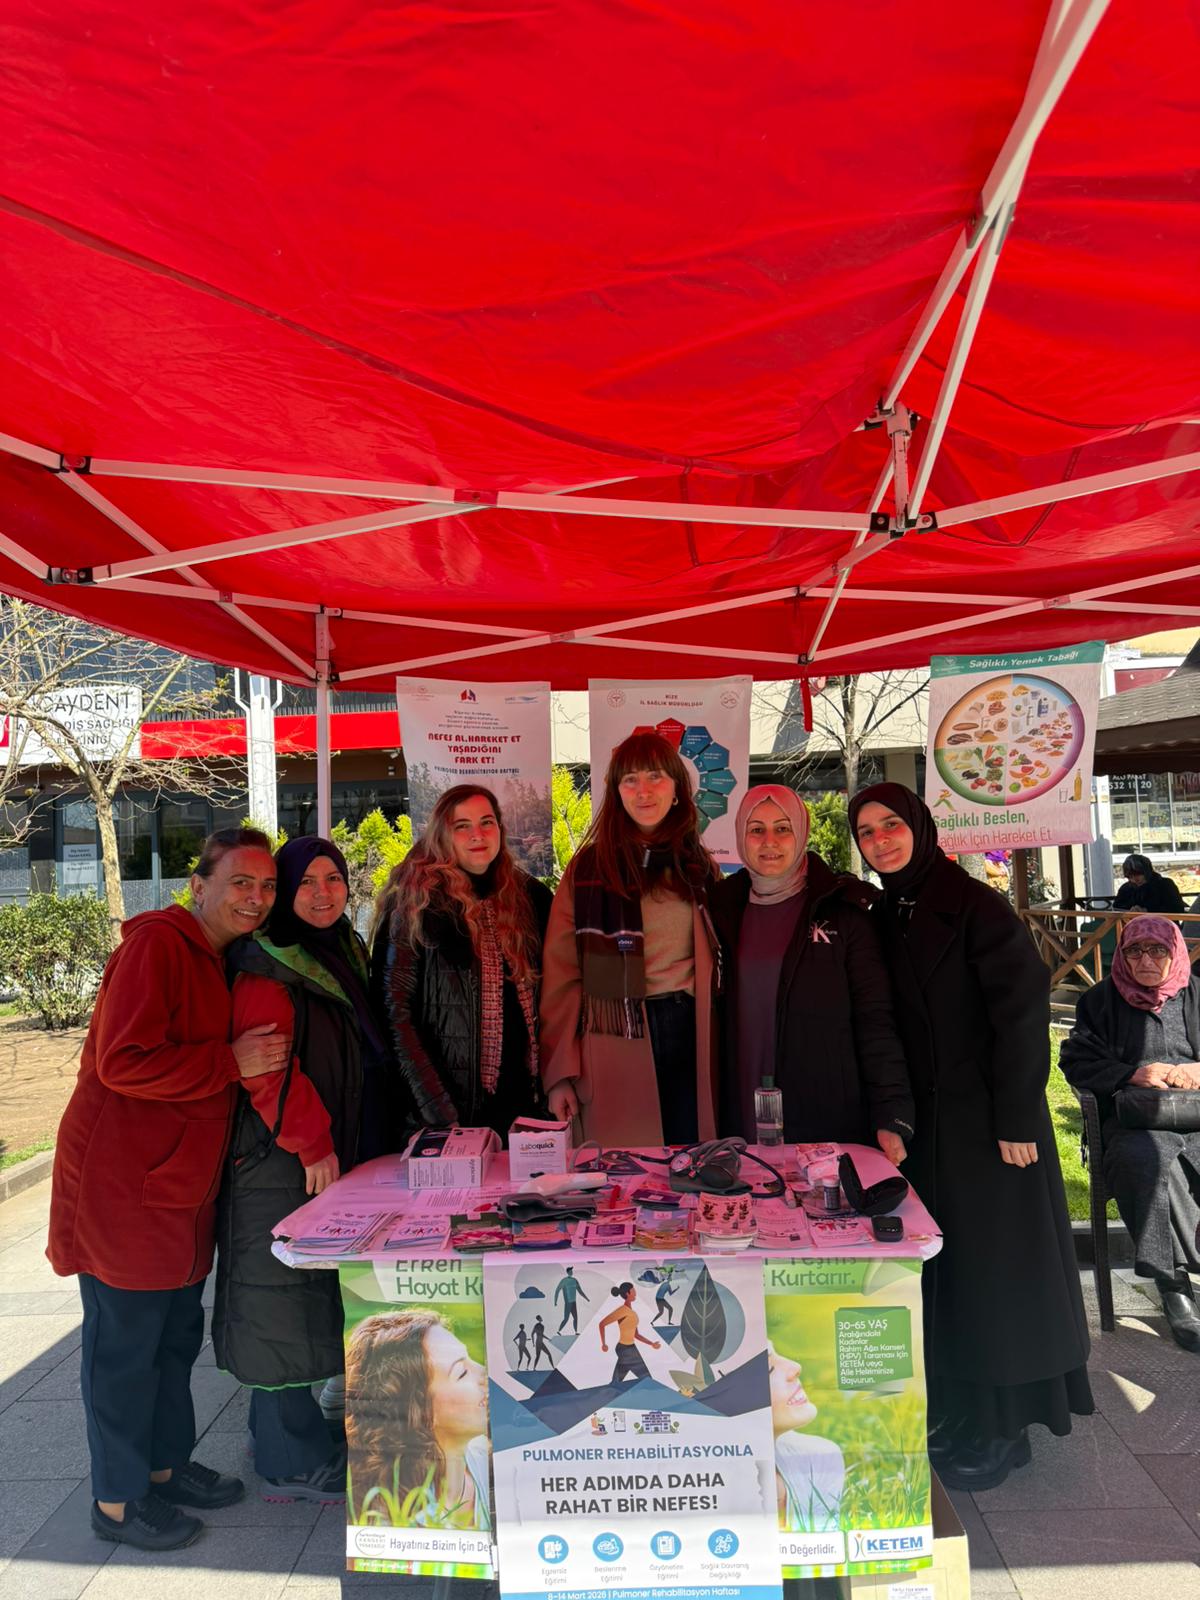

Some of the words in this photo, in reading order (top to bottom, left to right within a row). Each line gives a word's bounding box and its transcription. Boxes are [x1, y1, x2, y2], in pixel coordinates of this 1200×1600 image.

[969, 659, 1008, 669] Sağlıklı
[1010, 657, 1044, 666] Yemek
[1048, 650, 1080, 662] Tabağı
[428, 733, 453, 741] NEFES
[511, 735, 521, 743] ET
[448, 744, 501, 755] YAŞADIĞINI
[455, 756, 478, 764] FARK
[480, 756, 495, 764] ET!
[1141, 780, 1152, 789] 20
[933, 812, 979, 831] Sağlıklı
[984, 810, 1030, 826] Beslen,
[940, 833, 968, 850] ağlık
[992, 829, 1038, 845] Hareket
[1040, 826, 1053, 841] Et
[771, 1269, 855, 1287] Kurtarır.
[396, 1277, 459, 1299] Hayat
[465, 1276, 483, 1296] K
[838, 1321, 866, 1330] 30-65
[868, 1319, 888, 1331] YAŞ
[839, 1352, 862, 1360] (HPV)
[839, 1360, 865, 1368] KETEM
[840, 1368, 855, 1376] Aile
[855, 1367, 894, 1375] Hekiminize
[523, 1447, 604, 1462] PULMONER
[607, 1443, 753, 1460] REHABİLİTASYONLA
[541, 1476, 578, 1492] HER
[583, 1474, 663, 1491] ADIMDA
[667, 1472, 725, 1488] DAHA
[545, 1498, 612, 1515] RAHAT
[617, 1494, 649, 1513] BİR
[653, 1495, 718, 1512] NEFES!
[390, 1537, 430, 1552] Hayatınız
[432, 1539, 457, 1551] Bizim
[458, 1538, 475, 1553] İçin
[790, 1543, 837, 1557] Değerlidir.
[867, 1536, 923, 1551] KETEM
[547, 1592, 566, 1600] 8-14
[567, 1592, 586, 1600] Mart
[612, 1590, 650, 1598] Pulmoner
[652, 1588, 711, 1597] Rehabilitasyon
[711, 1587, 741, 1595] Haftası
